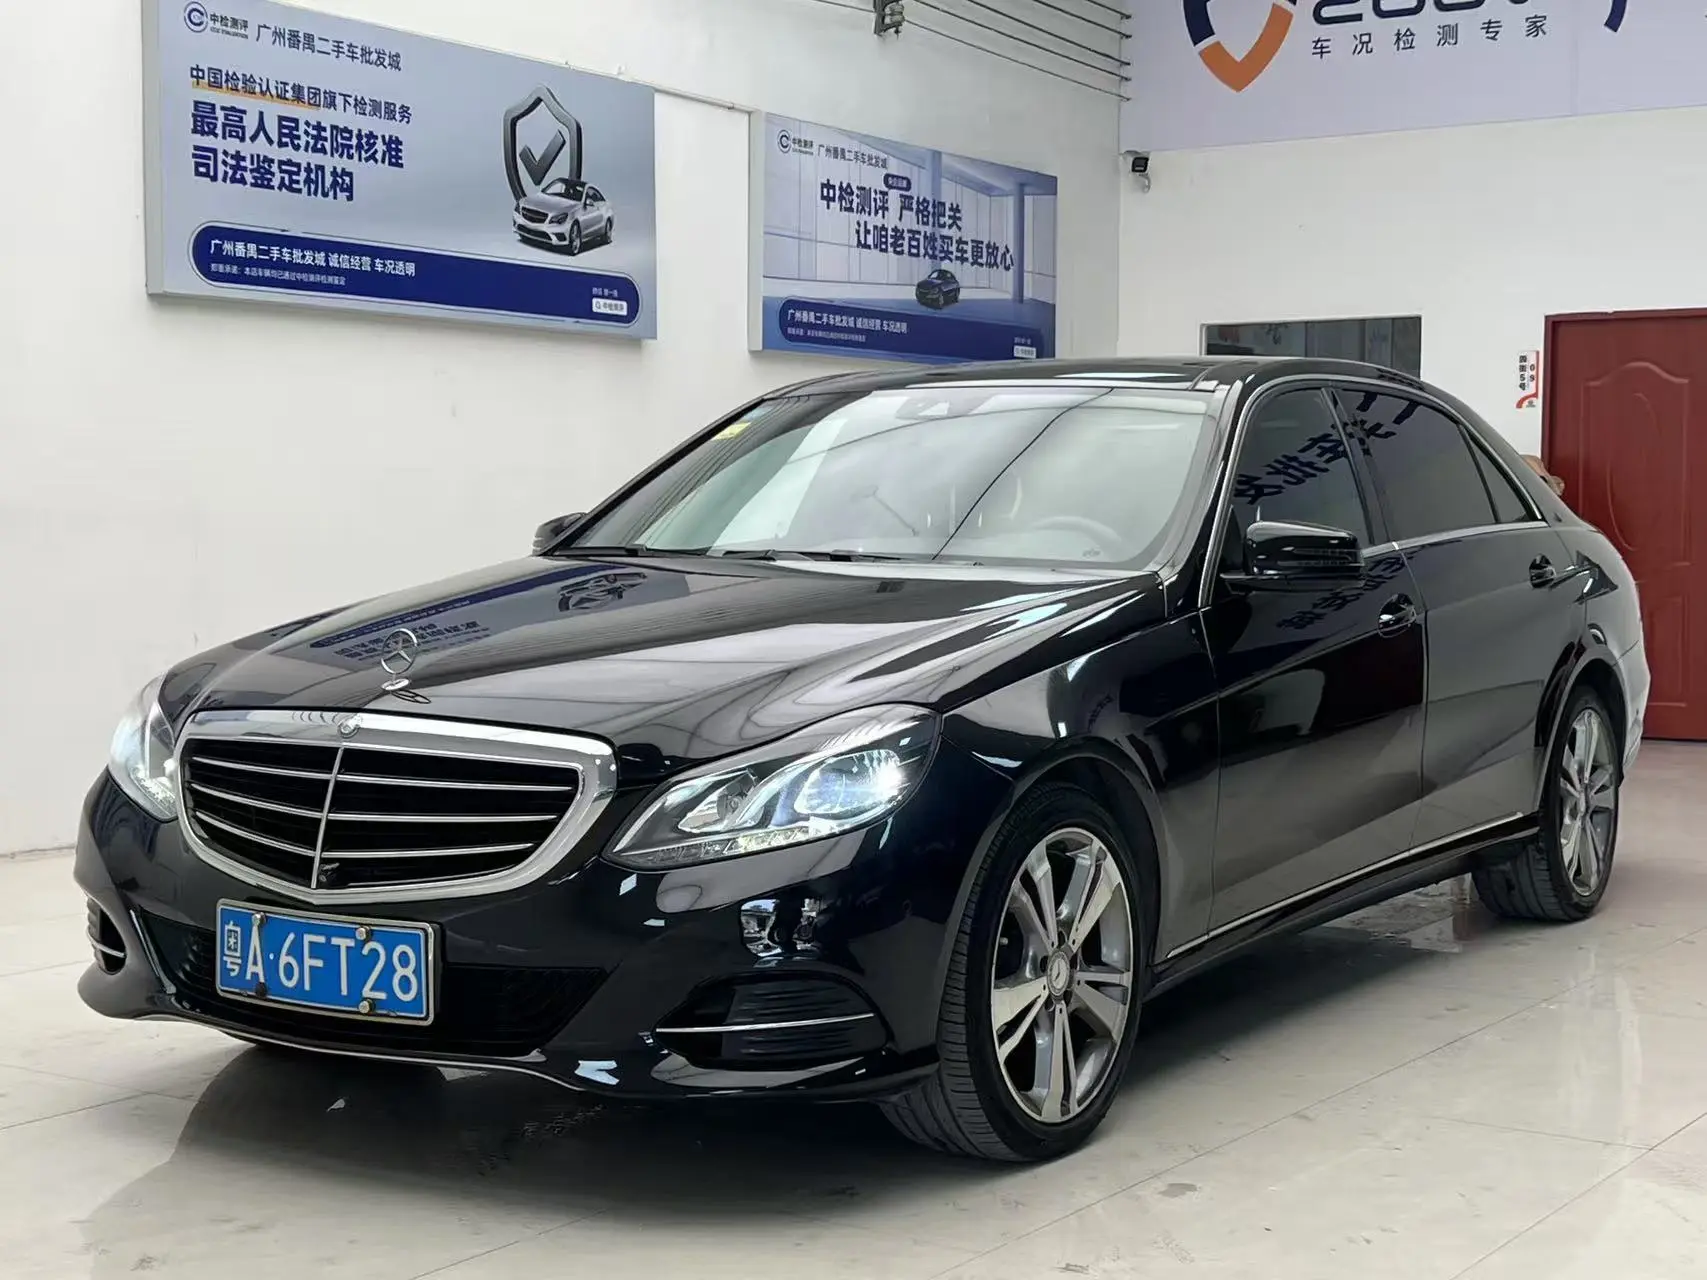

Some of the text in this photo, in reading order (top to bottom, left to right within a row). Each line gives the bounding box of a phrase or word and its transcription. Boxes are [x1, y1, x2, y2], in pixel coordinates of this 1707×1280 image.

[210, 12, 249, 32] 中检测评
[255, 23, 402, 71] 广州番禺二手车批发城
[1312, 14, 1548, 59] 车况检测专家
[190, 63, 412, 125] 中国检验认证集团旗下检测服务
[190, 100, 405, 168] 最高人民法院核准
[192, 144, 355, 201] 司法鉴定机构
[820, 178, 962, 232] 中检测评 严格把关
[210, 239, 416, 277] 广州番禺二手车批发城 诚信经营 车况透明
[855, 220, 1015, 271] 让咱老百姓买车更放心
